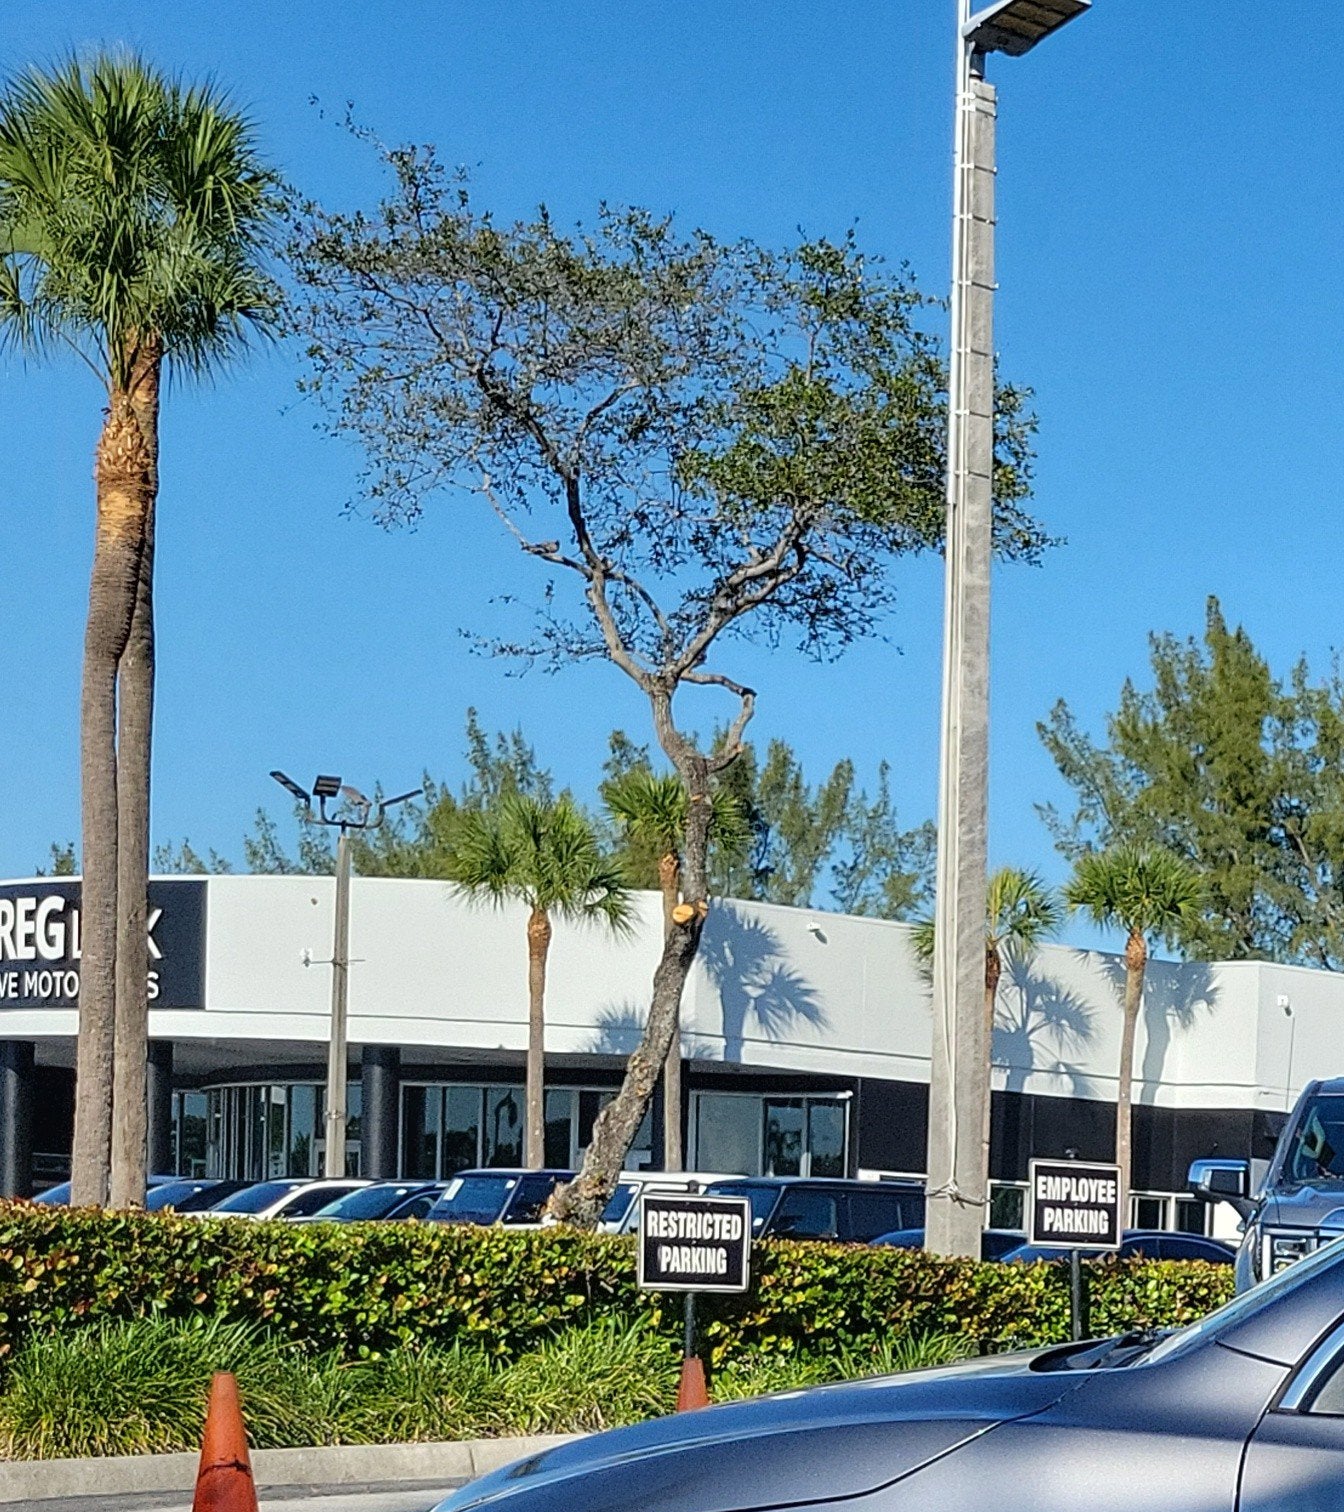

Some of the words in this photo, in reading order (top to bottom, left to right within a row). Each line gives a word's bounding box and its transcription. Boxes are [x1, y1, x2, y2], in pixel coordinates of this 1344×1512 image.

[1037, 1175, 1116, 1204] EMPLOYEE
[647, 1210, 742, 1240] RESTRICTED
[1043, 1207, 1109, 1234] PARKING
[660, 1245, 727, 1275] PARKING
